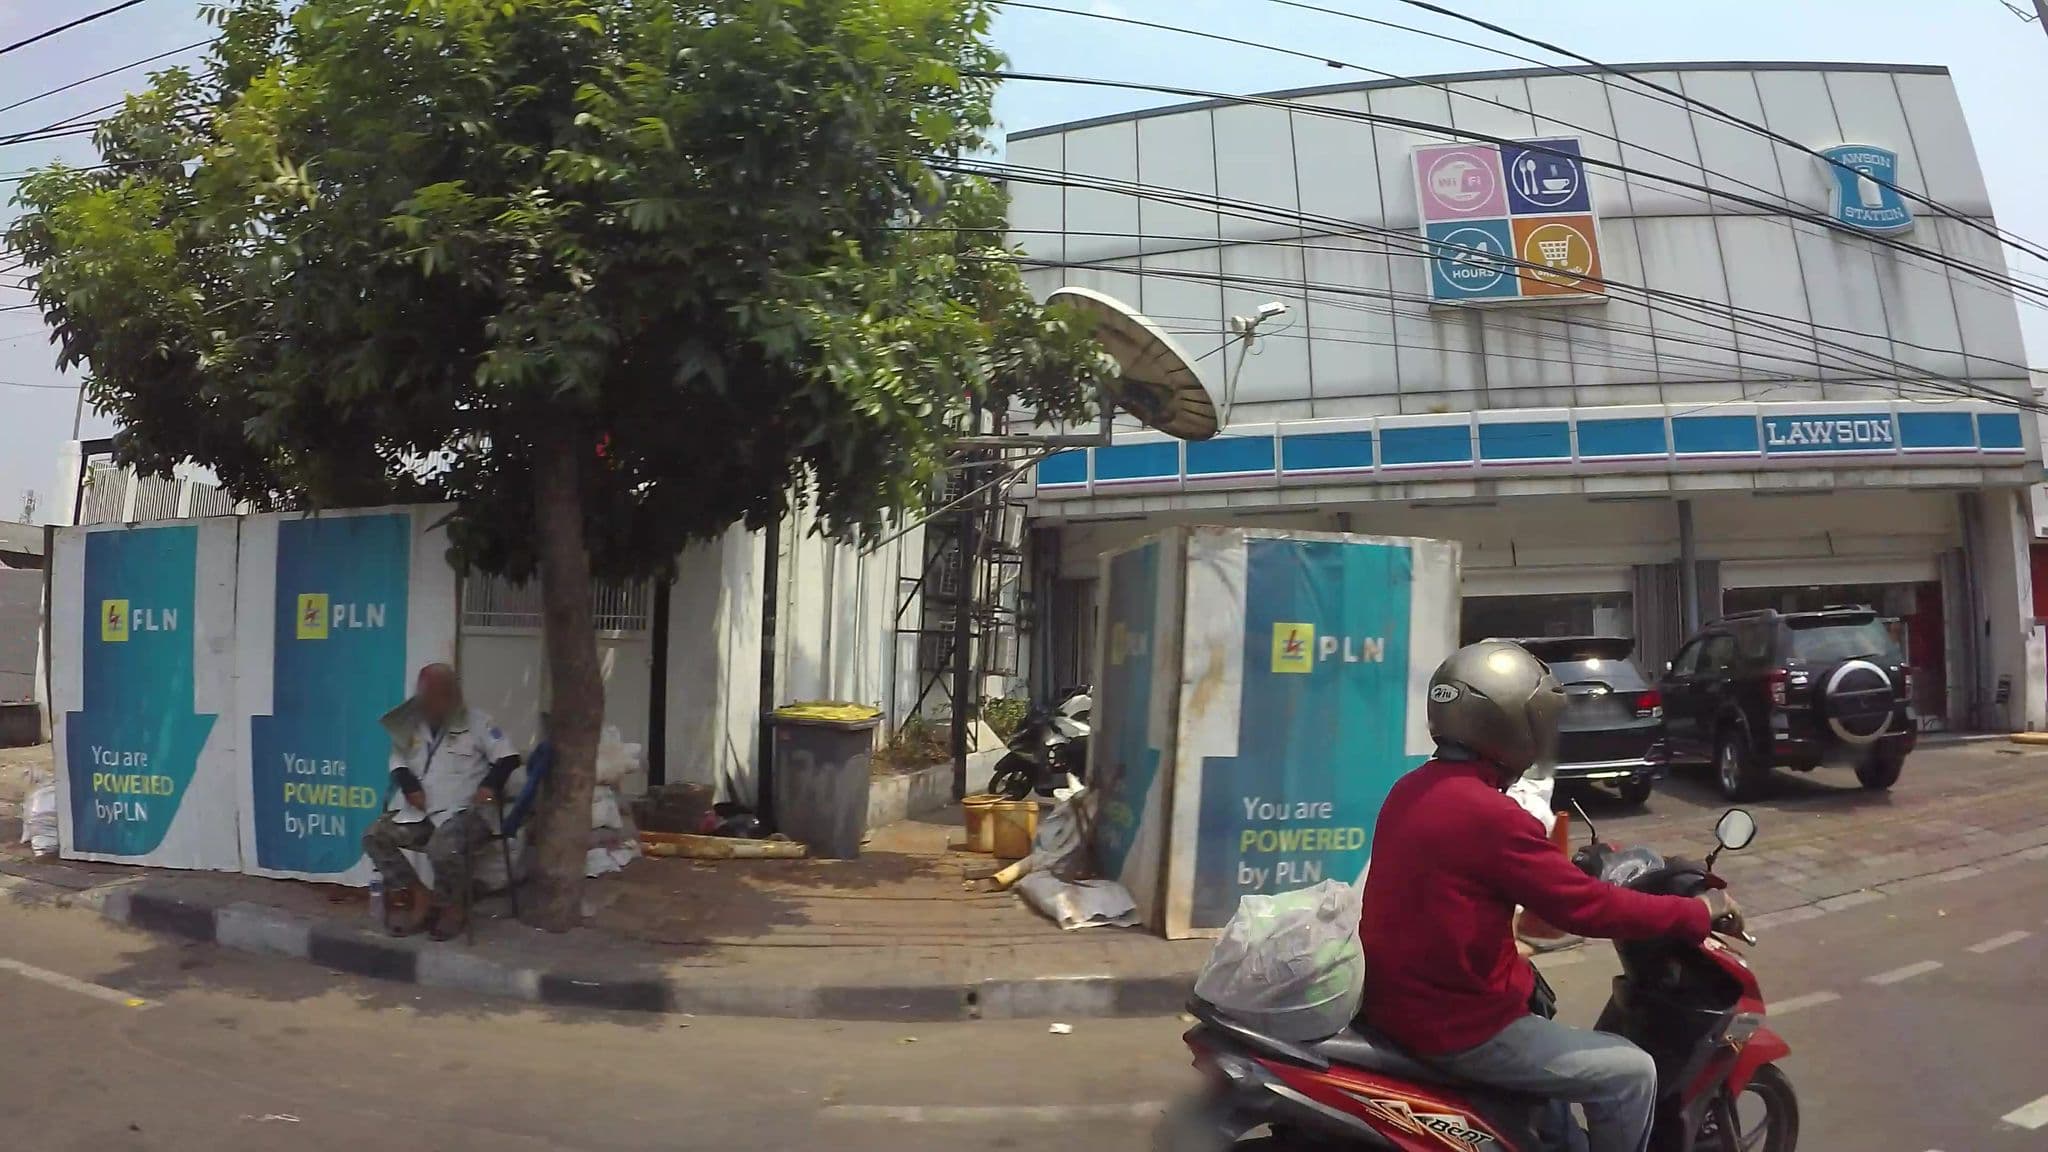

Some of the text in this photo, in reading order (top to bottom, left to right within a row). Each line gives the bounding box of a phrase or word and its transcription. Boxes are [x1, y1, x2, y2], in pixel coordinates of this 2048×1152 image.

[1844, 206, 1904, 221] STATION
[1452, 242, 1491, 265] 24
[1452, 268, 1496, 279] HOURS
[1766, 420, 1893, 445] LAWSON
[333, 603, 386, 628] PLN
[1319, 636, 1385, 663] PLN
[123, 751, 148, 767] are
[321, 759, 346, 776] are
[95, 799, 147, 824] by PLN
[1243, 797, 1333, 820] You are
[285, 811, 345, 839] by PLN
[1240, 827, 1365, 853] POWERED
[1237, 861, 1322, 890] by PLN
